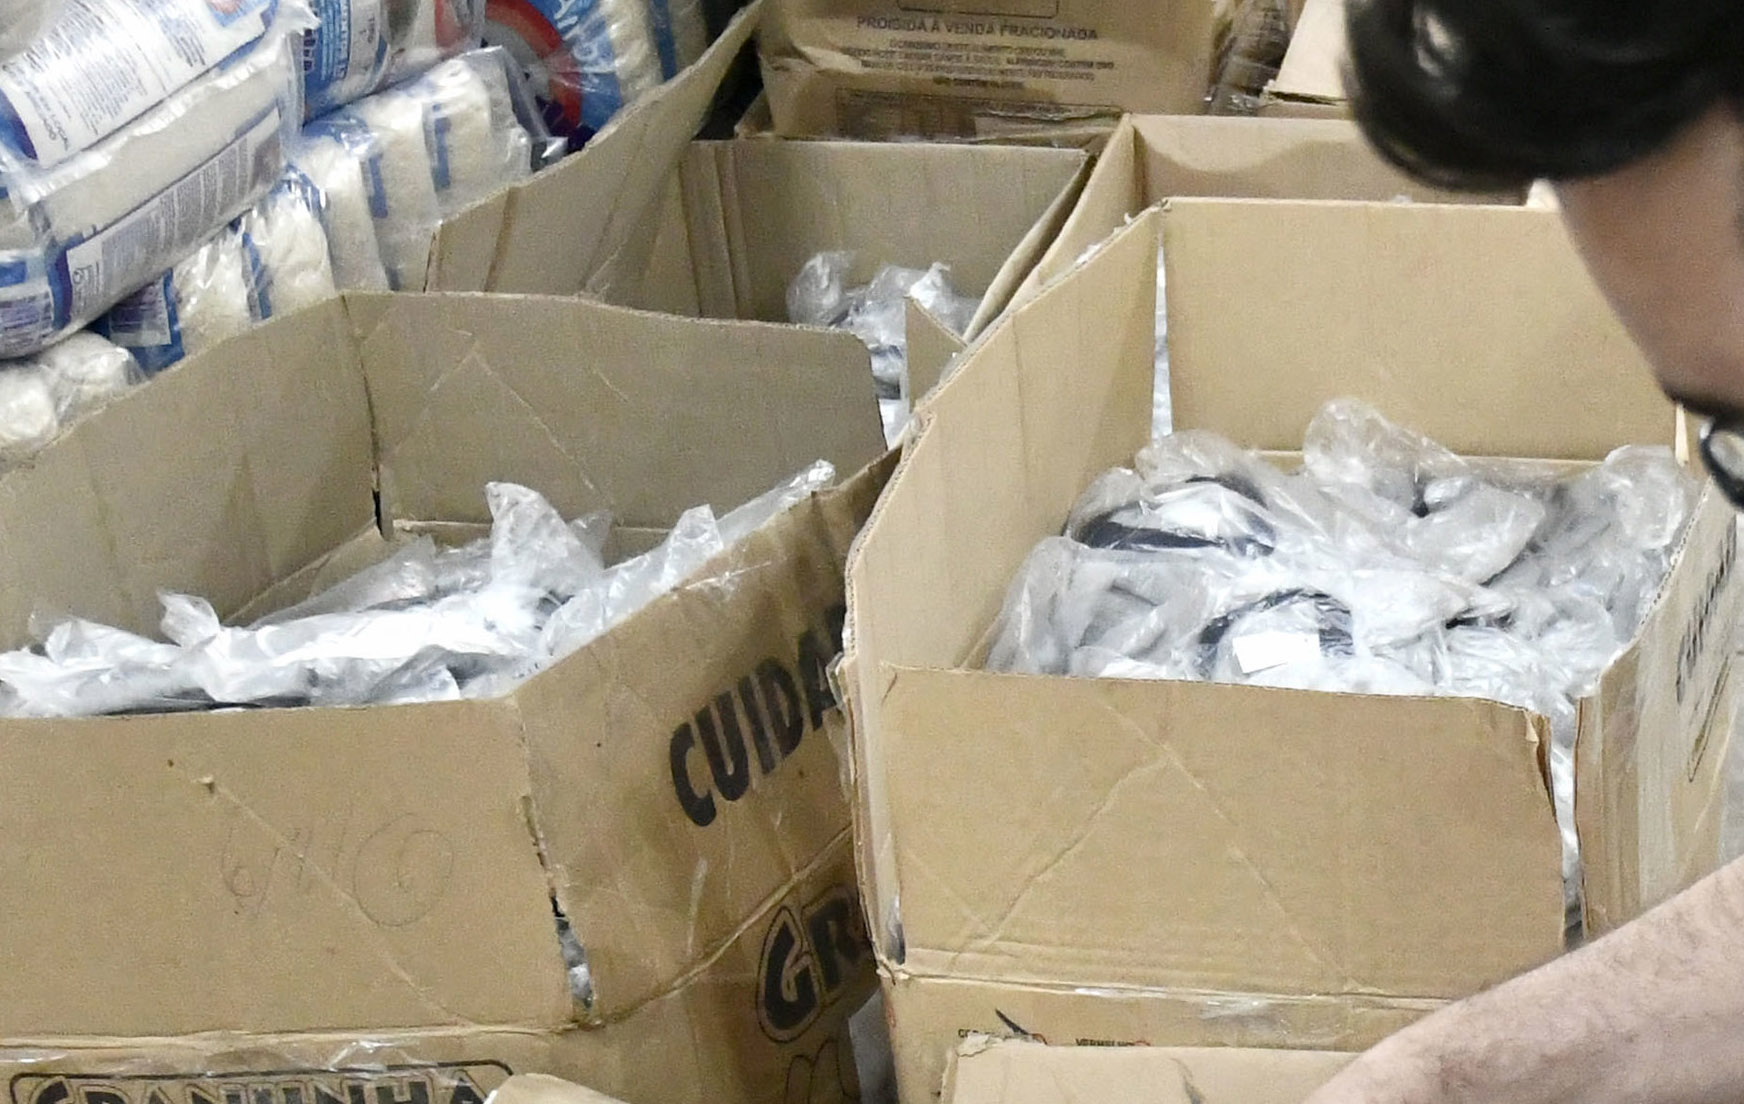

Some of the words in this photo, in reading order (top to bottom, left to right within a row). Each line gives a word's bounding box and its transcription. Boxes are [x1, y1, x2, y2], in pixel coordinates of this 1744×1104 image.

[856, 15, 927, 34] PROIBIDA
[944, 19, 994, 36] VENDA
[1000, 22, 1099, 41] FRACIONADA
